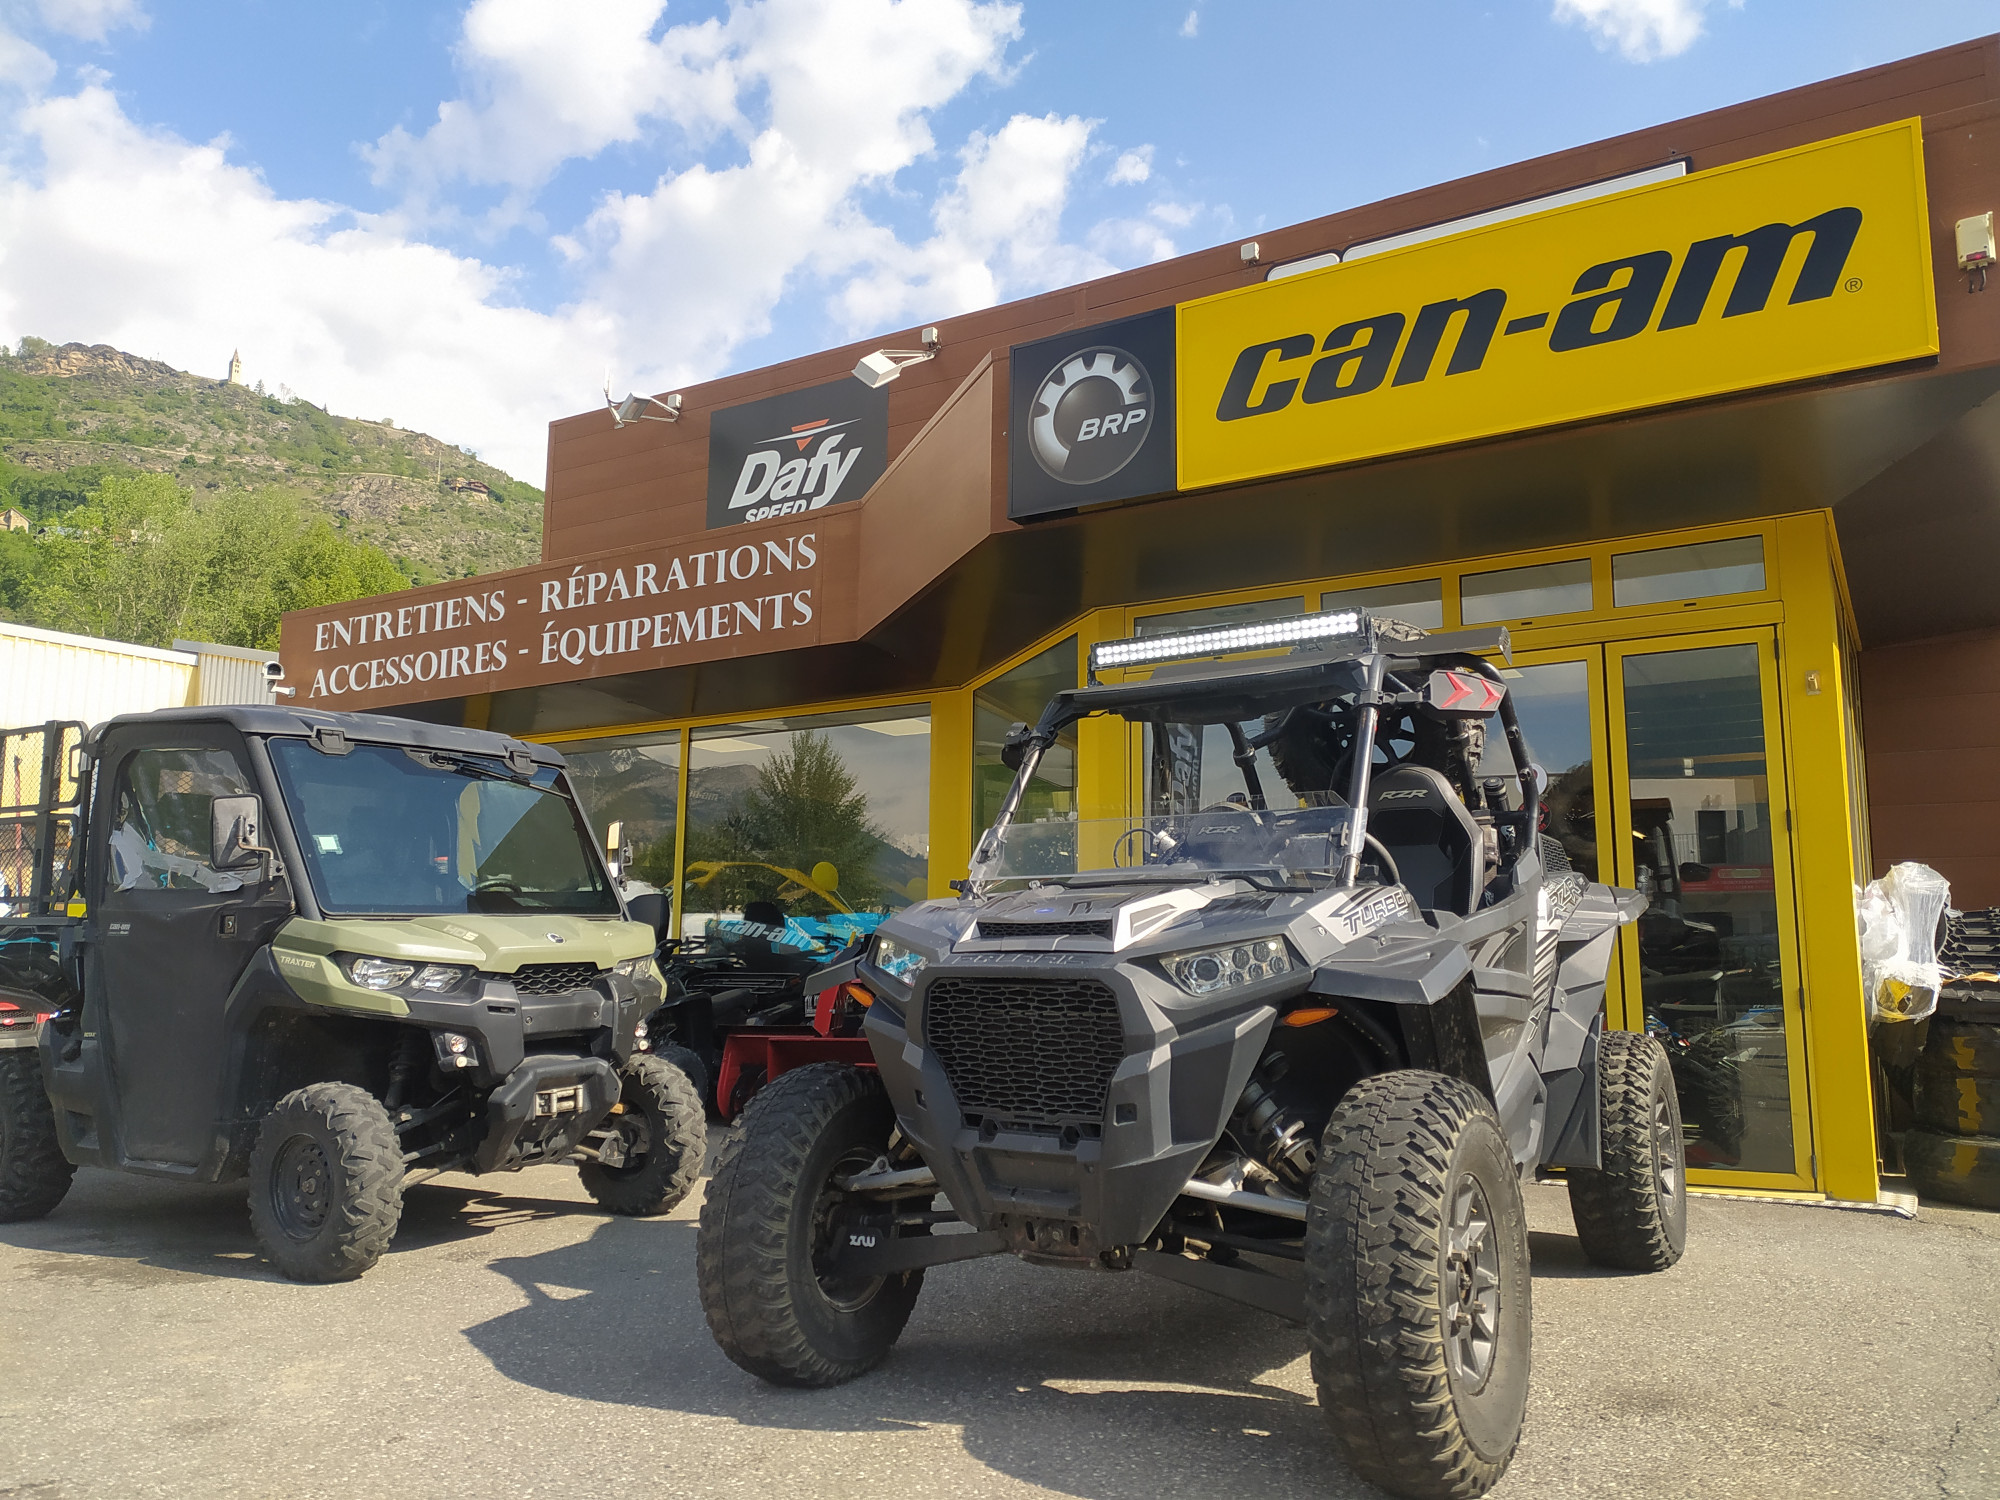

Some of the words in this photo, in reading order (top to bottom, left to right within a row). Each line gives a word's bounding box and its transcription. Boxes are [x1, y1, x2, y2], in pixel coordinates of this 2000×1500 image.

[1217, 206, 1862, 421] can-am
[1077, 408, 1147, 442] BRP
[728, 433, 863, 510] Dafy
[744, 499, 807, 524] SPEED
[314, 590, 505, 652] ENTRETIENS
[540, 533, 817, 614] RÉPARATIONS
[308, 639, 507, 698] ACCESSOIRES
[539, 590, 813, 666] ÉQUIPEMENTS
[1378, 789, 1428, 801] RZR
[1342, 889, 1409, 936] TURBO
[280, 955, 316, 969] TRAXTER
